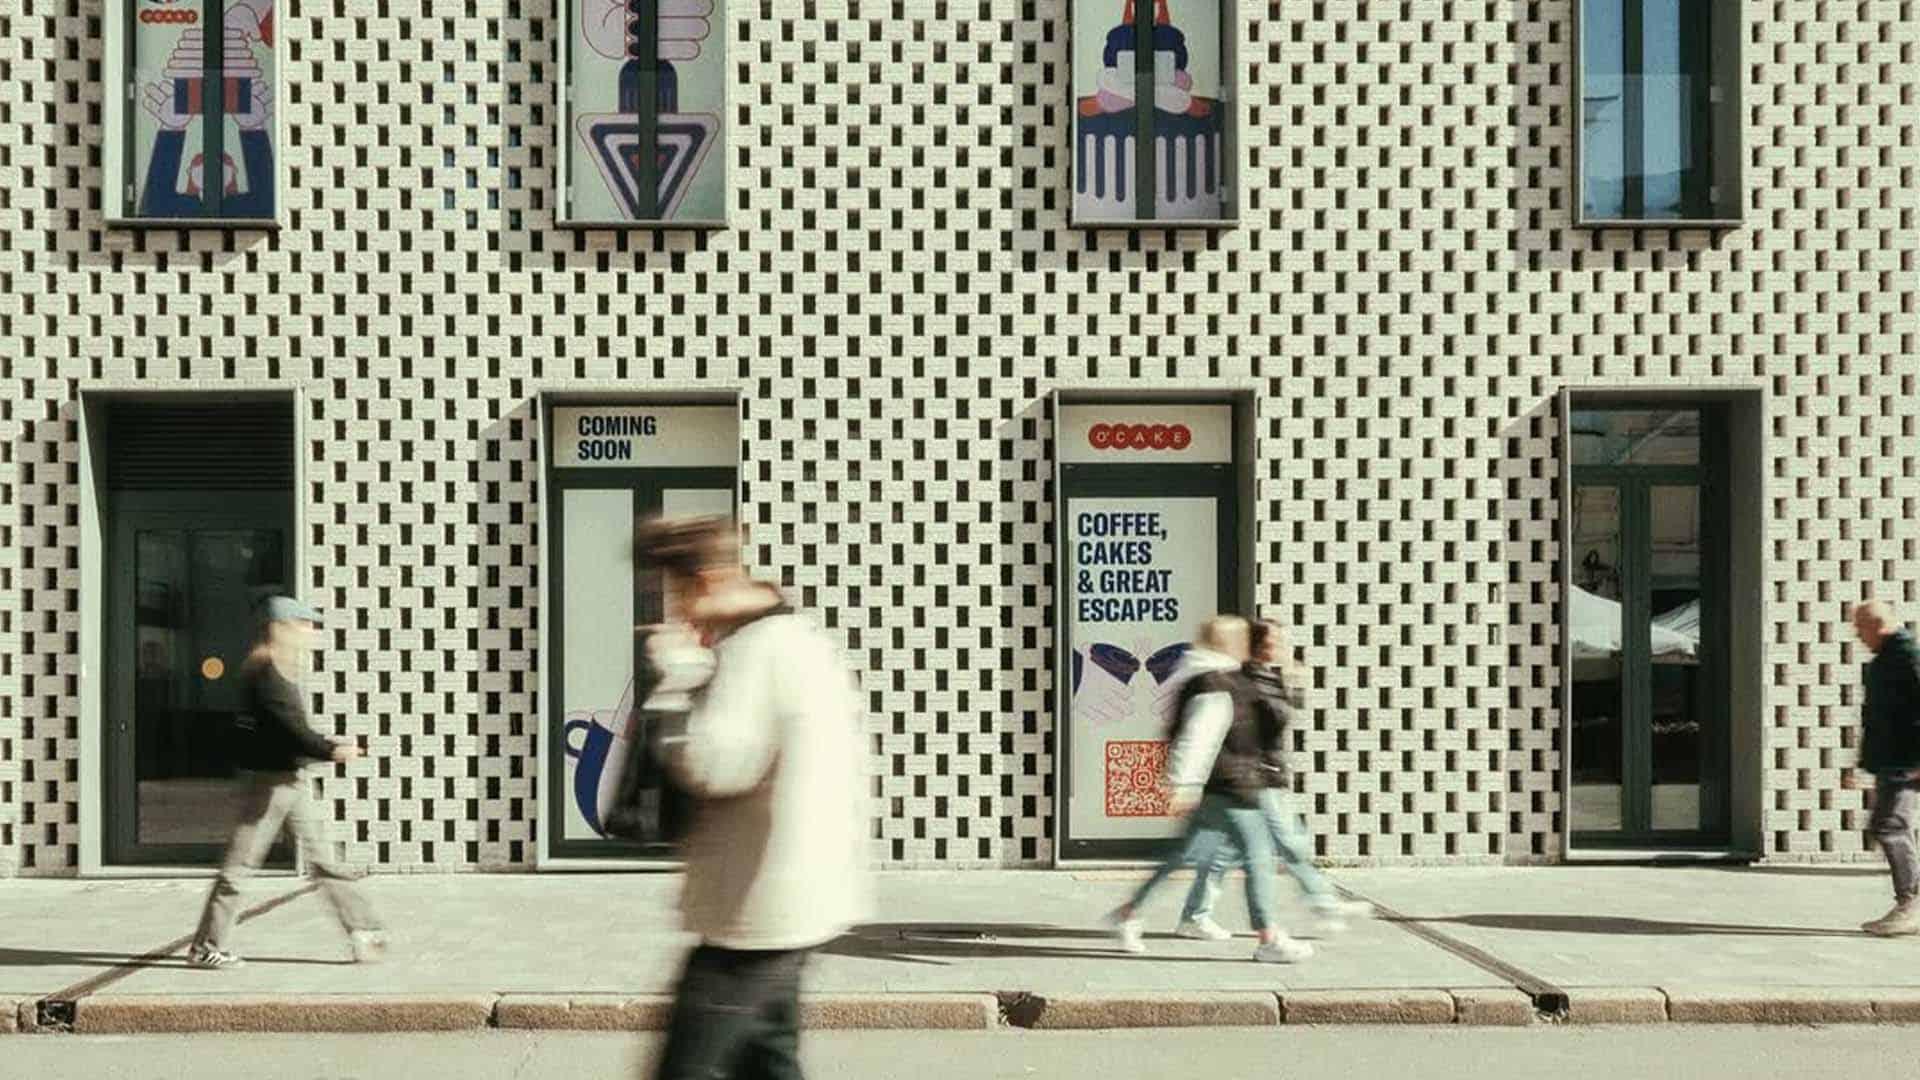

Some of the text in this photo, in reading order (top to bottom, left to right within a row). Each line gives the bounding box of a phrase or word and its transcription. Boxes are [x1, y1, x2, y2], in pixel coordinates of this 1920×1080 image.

[578, 416, 657, 436] COMING
[578, 440, 632, 460] SOON
[1078, 513, 1168, 541] COFFEE,
[1078, 541, 1152, 565] CAKES
[1078, 570, 1172, 593] & GREAT
[1078, 598, 1179, 622] ESCAPES
